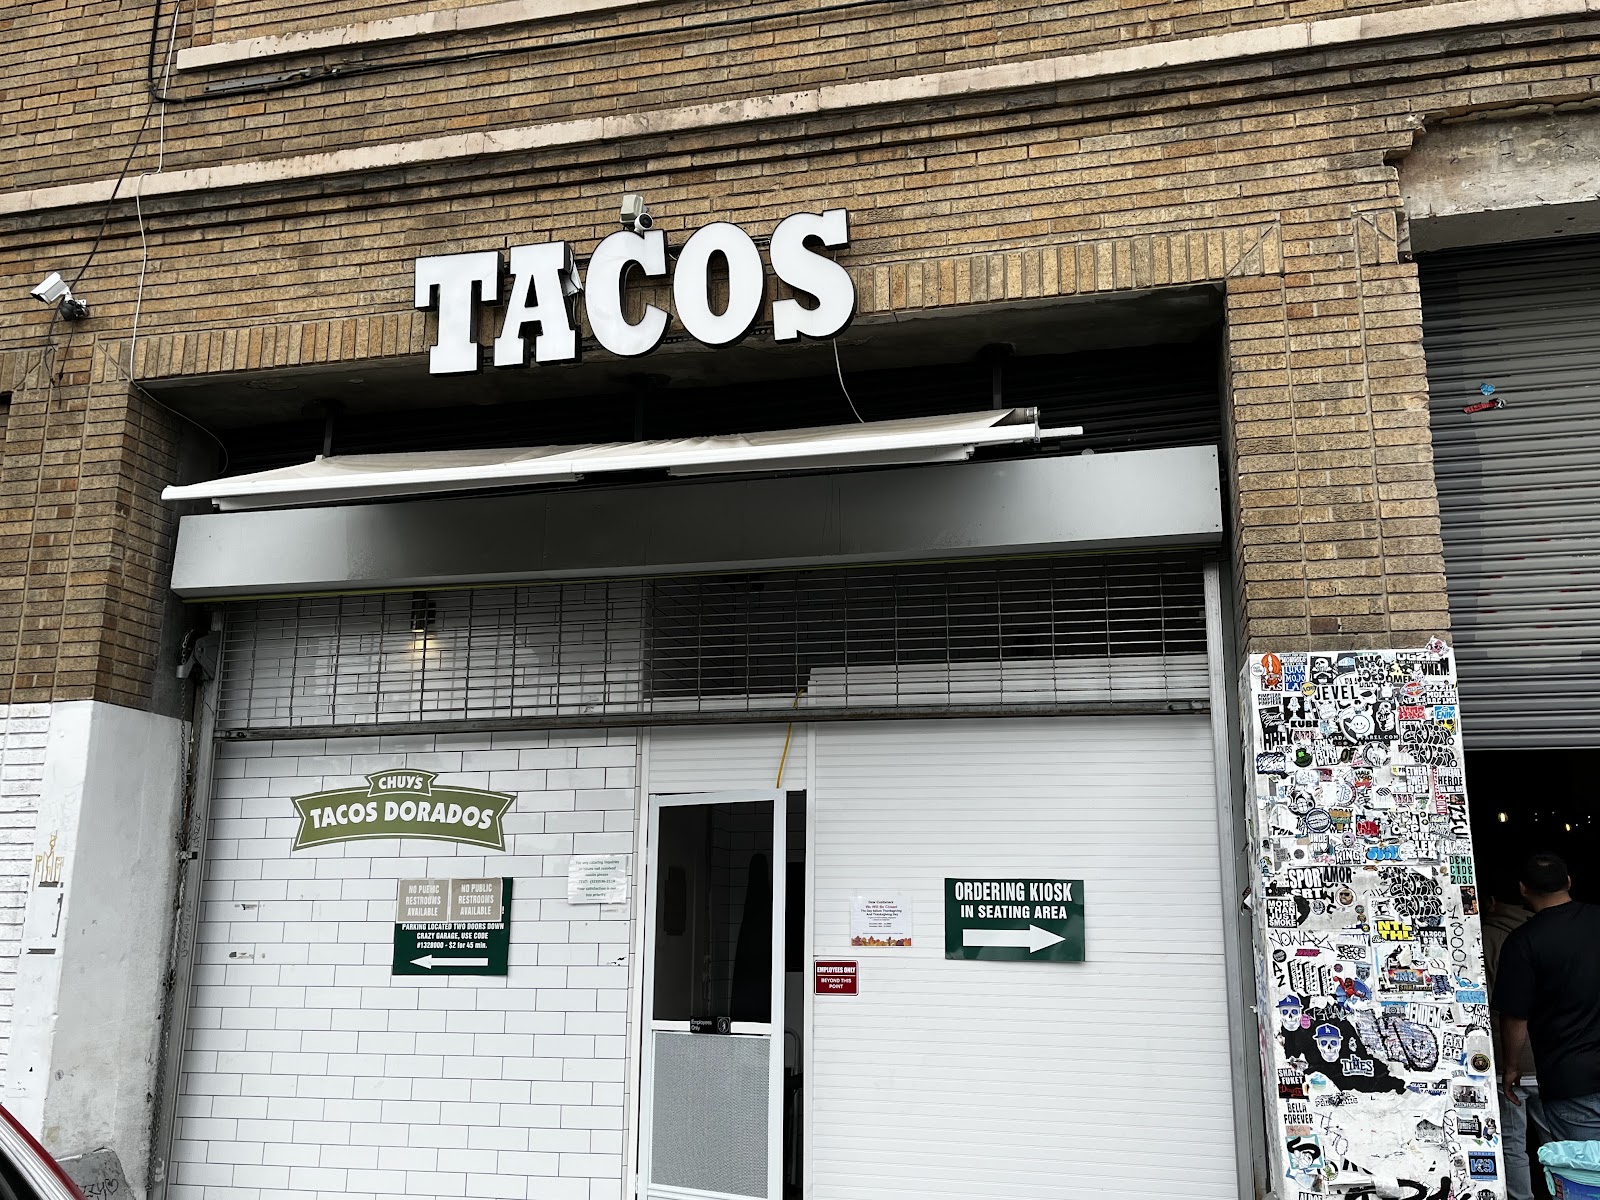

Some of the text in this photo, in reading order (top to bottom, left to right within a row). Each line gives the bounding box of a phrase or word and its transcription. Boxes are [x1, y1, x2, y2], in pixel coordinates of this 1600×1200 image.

[414, 208, 857, 376] TACOS
[378, 775, 424, 790] CHUY'S
[309, 801, 494, 830] TACOS DORADOS
[408, 885, 418, 894] NO
[461, 883, 493, 893] NO PUBLIC
[955, 882, 1073, 902] ORDERING KIOSK
[405, 896, 441, 905] RESTROOMS
[458, 895, 494, 904] RESTROOMS
[407, 907, 438, 917] AVAILABLE
[460, 906, 491, 916] AVAILABLE
[960, 905, 1067, 919] IN SEATING AREA
[401, 922, 505, 931] PARKING LOCATED TWO DOORS DOWN
[1268, 919, 1297, 927] SMOKE
[416, 932, 489, 941] CRAZY GARAGE, USE CODE
[448, 941, 456, 950] $2
[457, 941, 466, 949] for
[466, 941, 474, 949] 45
[1287, 1102, 1307, 1113] BELLA
[1283, 1113, 1313, 1125] FOREVER
